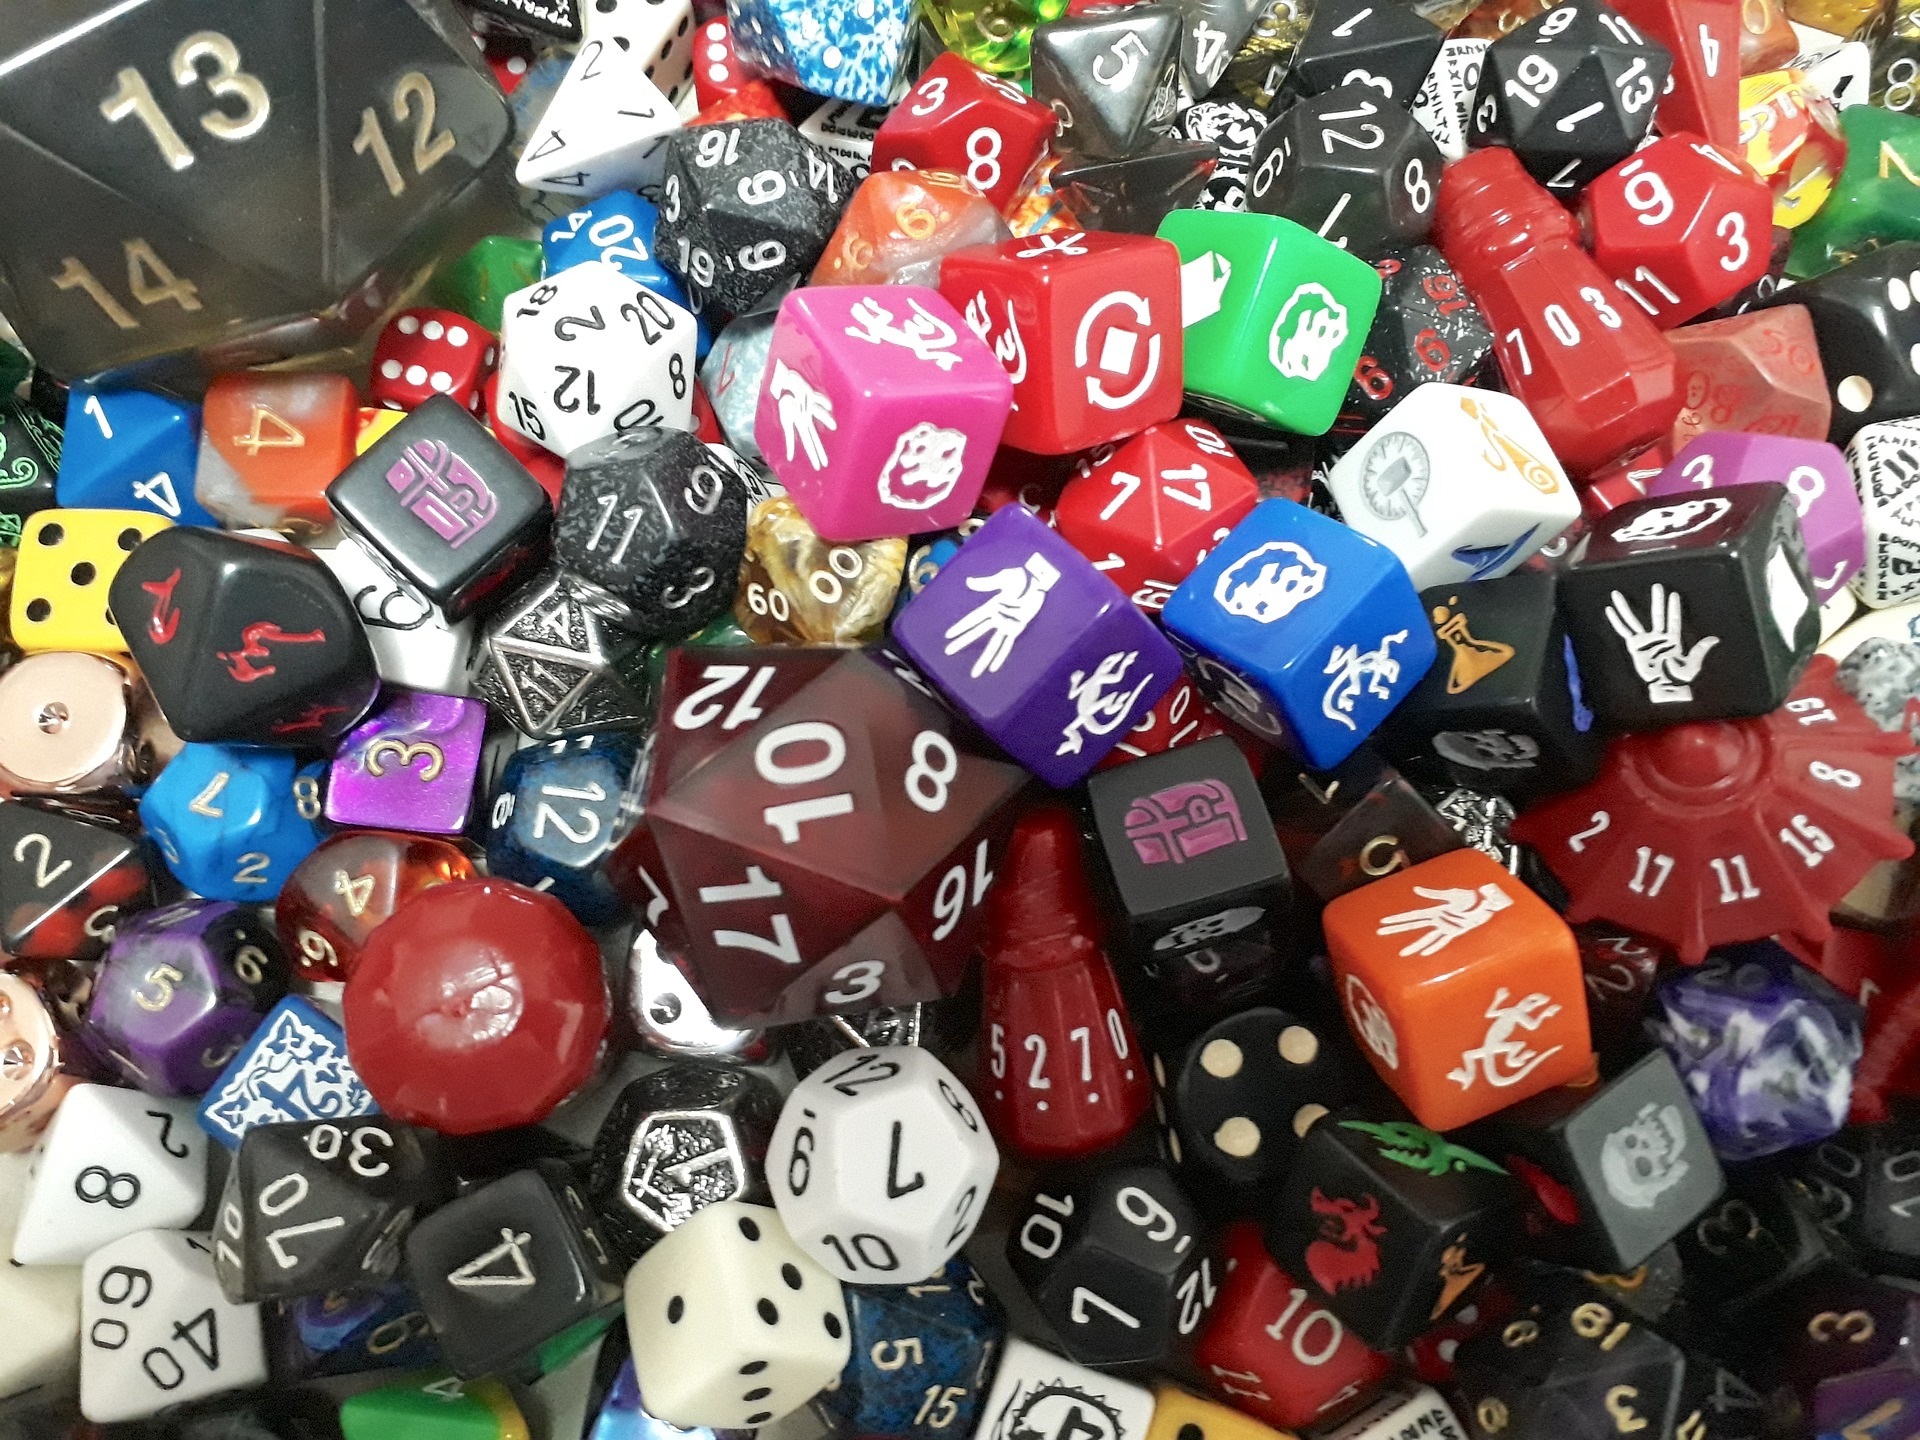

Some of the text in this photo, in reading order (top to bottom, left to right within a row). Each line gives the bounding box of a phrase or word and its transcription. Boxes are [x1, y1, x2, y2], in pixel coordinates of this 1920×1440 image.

[580, 40, 603, 81] 2
[1092, 31, 1150, 87] 5
[1197, 20, 1228, 75] 4
[1699, 23, 1720, 77] 4
[100, 30, 270, 171] 13
[910, 77, 948, 116] 3
[1505, 54, 1560, 108] 19
[1613, 57, 1657, 114] 13
[1884, 57, 1918, 112] 8
[353, 71, 456, 196] 12
[1318, 101, 1385, 154] 12
[1476, 94, 1498, 134] 3
[1556, 101, 1604, 132] 1
[528, 130, 567, 162] 4
[966, 126, 1002, 191] 8
[664, 174, 681, 222] 3
[808, 148, 838, 203] 14
[1403, 158, 1432, 214] 8
[1546, 158, 1582, 188] 7
[550, 209, 593, 242] 14
[588, 214, 650, 271] 20
[1715, 211, 1750, 272] 3
[50, 238, 202, 328] 14
[674, 236, 715, 288] 19
[516, 285, 557, 318] 18
[1580, 286, 1622, 329] 3
[1615, 265, 1681, 316] 11
[555, 306, 606, 341] 2
[620, 291, 676, 345] 20
[1543, 304, 1581, 348] 0
[553, 366, 601, 415] 12
[669, 353, 686, 399] 8
[84, 395, 112, 439] 1
[232, 402, 305, 457] 4
[508, 391, 546, 441] 15
[1185, 424, 1233, 457] 10
[133, 471, 182, 518] 4
[1161, 463, 1212, 512] 17
[585, 495, 644, 564] 11
[663, 567, 716, 610] 3
[809, 548, 862, 603] 00
[747, 586, 790, 622] 60
[672, 664, 776, 731] 12
[365, 737, 446, 783] 3
[754, 721, 855, 845] 10
[904, 729, 958, 813] 8
[1808, 760, 1862, 789] 8
[189, 770, 231, 818] 7
[291, 774, 323, 821] 8
[530, 781, 607, 845] 12
[1568, 810, 1611, 852] 2
[1778, 814, 1836, 868] 15
[13, 832, 73, 890] 2
[232, 851, 271, 884] 2
[1628, 846, 1675, 897] 17
[1710, 854, 1761, 903] 11
[334, 869, 375, 917] 4
[698, 865, 803, 965] 17
[931, 838, 994, 941] 16
[134, 963, 183, 1012] 5
[823, 960, 886, 1005] 3
[823, 1054, 900, 1096] 12
[1023, 1033, 1051, 1090] 2
[937, 1078, 979, 1133] 8
[145, 1109, 190, 1159] 2
[308, 1122, 394, 1178] 30
[74, 1164, 141, 1210] 8
[258, 1172, 346, 1269] 70
[945, 1185, 979, 1248] 2
[1019, 1193, 1075, 1259] 10
[446, 1227, 537, 1288] 4
[822, 1232, 900, 1272] 10
[90, 1265, 153, 1351] 60
[1176, 1257, 1217, 1335] 12
[142, 1308, 220, 1391] 40
[1264, 1287, 1345, 1367] 10
[1807, 1310, 1877, 1345] 3
[870, 1337, 924, 1371] 5
[913, 1384, 968, 1429] 15
[1210, 1364, 1272, 1402] 11
[1604, 1383, 1649, 1434] 3
